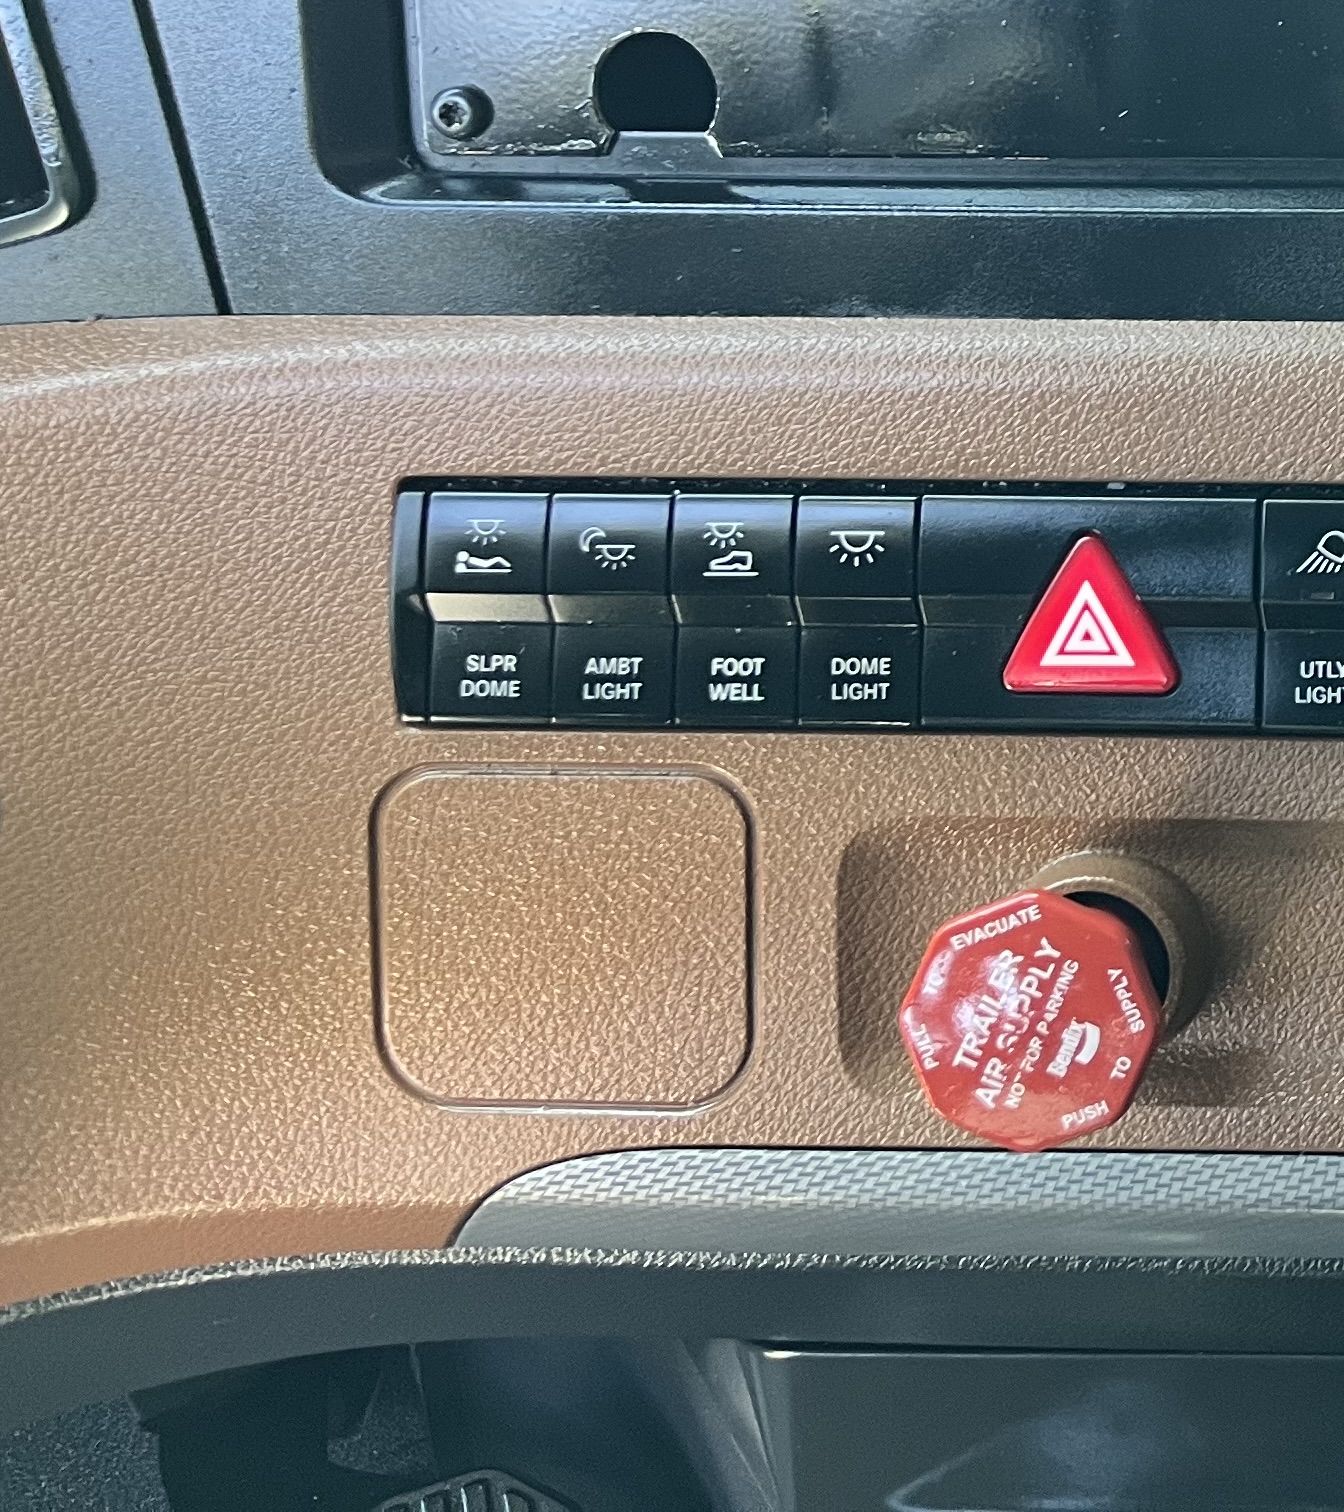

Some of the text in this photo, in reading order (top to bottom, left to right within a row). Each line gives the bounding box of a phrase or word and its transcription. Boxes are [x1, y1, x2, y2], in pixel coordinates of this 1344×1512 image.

[467, 654, 517, 673] SLPR
[585, 658, 643, 674] AMBT
[711, 658, 765, 676] FOOT
[831, 658, 891, 675] DOME
[461, 680, 520, 697] DOME
[583, 683, 642, 699] LIGHT
[709, 683, 764, 701] WELL
[832, 683, 890, 700] LIGHT
[951, 905, 1042, 951] EVACUATE
[952, 949, 1024, 1072] TRAILER
[1020, 1036, 1042, 1073] FOR
[1038, 959, 1079, 1034] PARKING
[973, 937, 1061, 1109] AIR SUPPLY
[1047, 1016, 1086, 1078] Bendix
[1061, 968, 1145, 1129] PUSH TO SUPPLY
